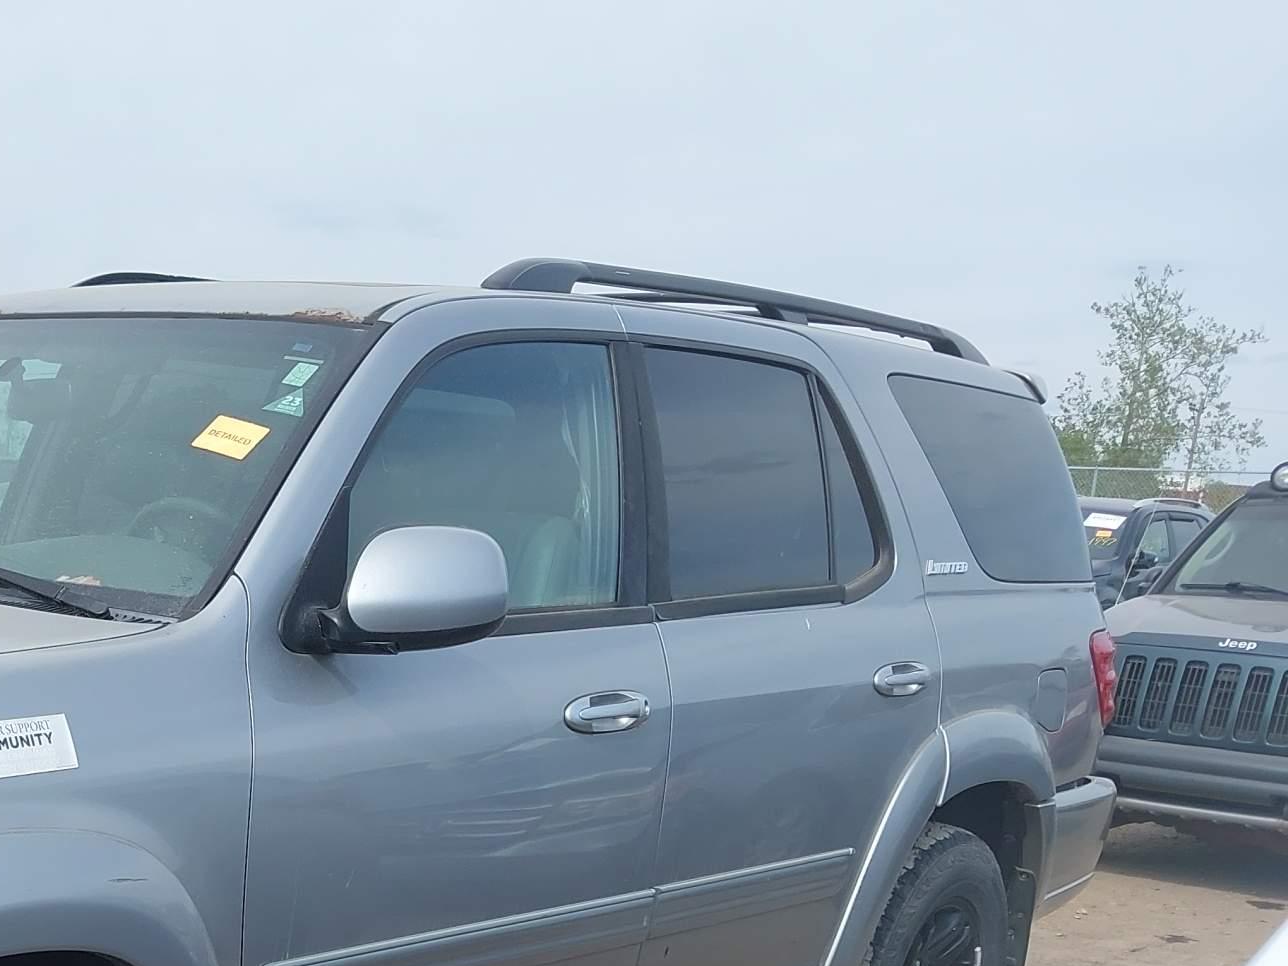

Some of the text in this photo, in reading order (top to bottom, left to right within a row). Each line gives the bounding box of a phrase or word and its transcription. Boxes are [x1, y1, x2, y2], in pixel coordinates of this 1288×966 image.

[207, 428, 253, 446] DETAILED
[1218, 638, 1258, 651] Jeep
[5, 719, 51, 734] SUPPORT
